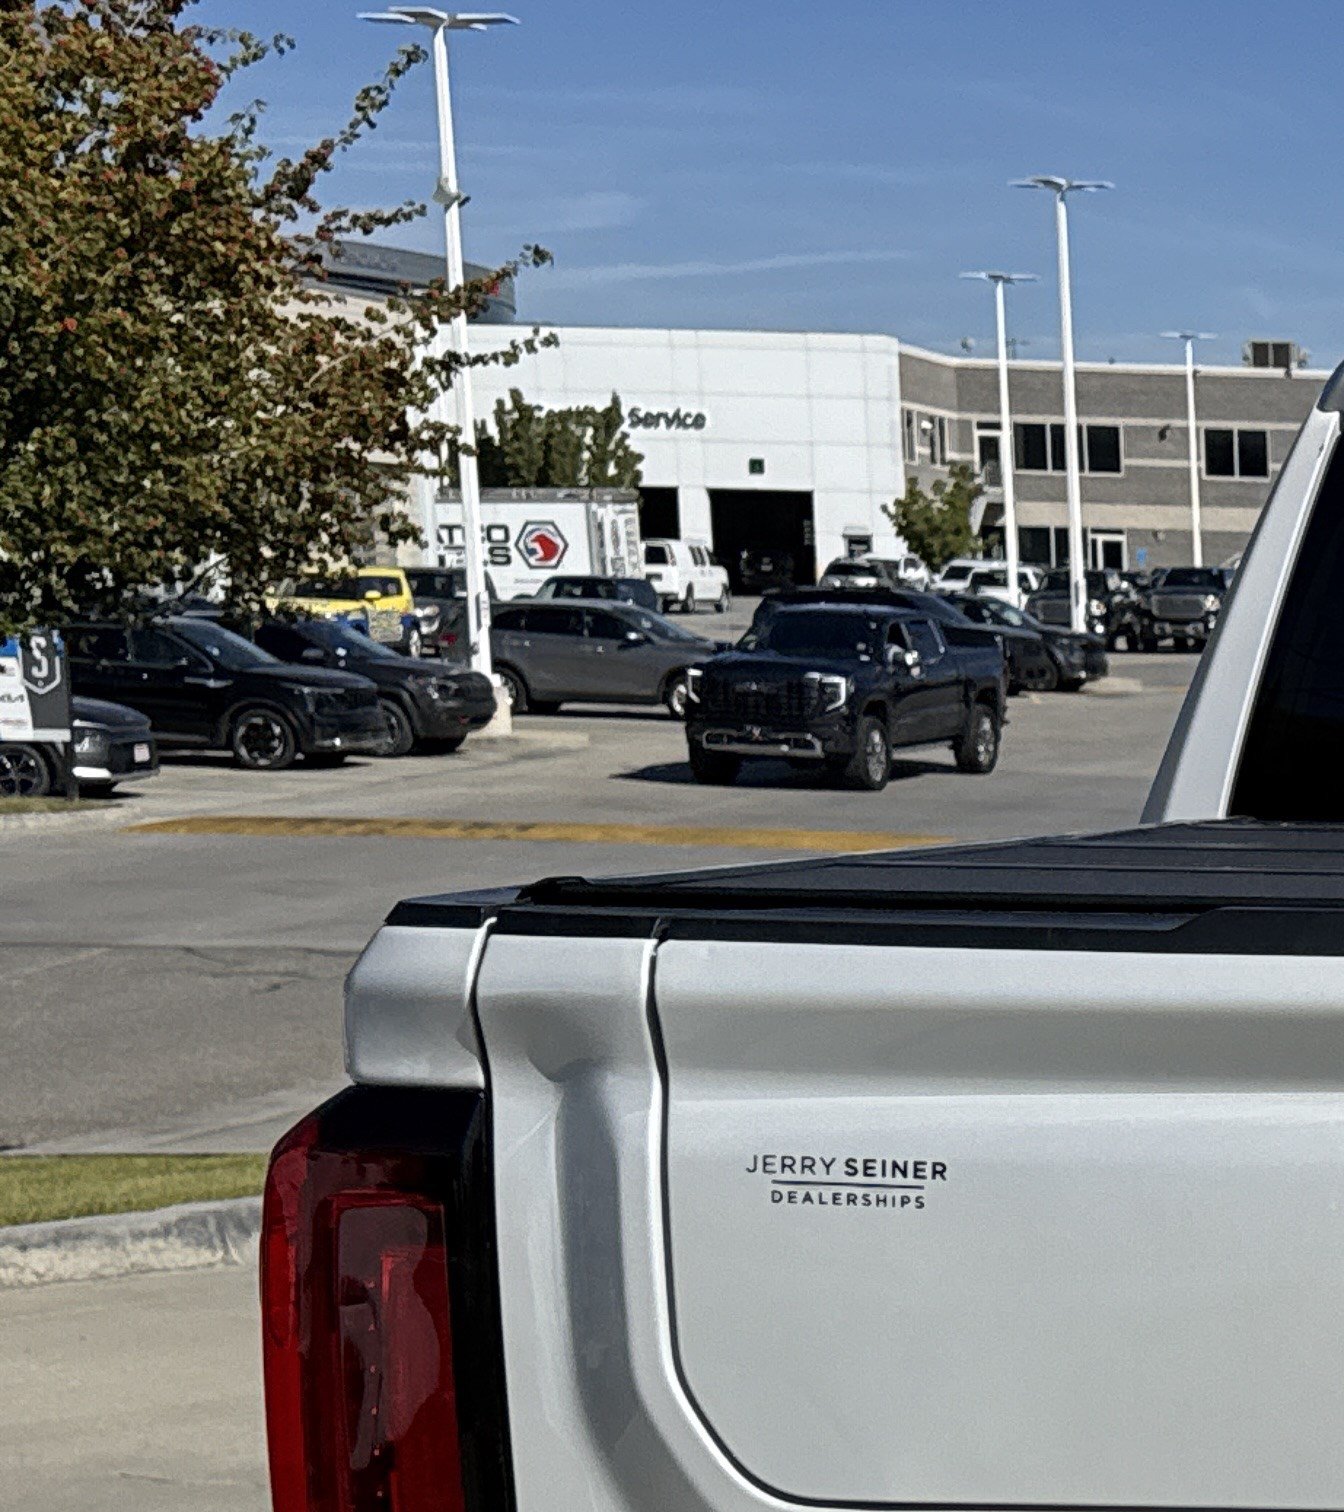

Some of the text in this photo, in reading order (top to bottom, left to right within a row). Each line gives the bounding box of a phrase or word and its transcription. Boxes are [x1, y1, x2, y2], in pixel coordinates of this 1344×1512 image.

[628, 407, 706, 430] Service
[746, 1154, 947, 1181] JERRY SEINER
[771, 1190, 925, 1209] DEALERSHIPS
